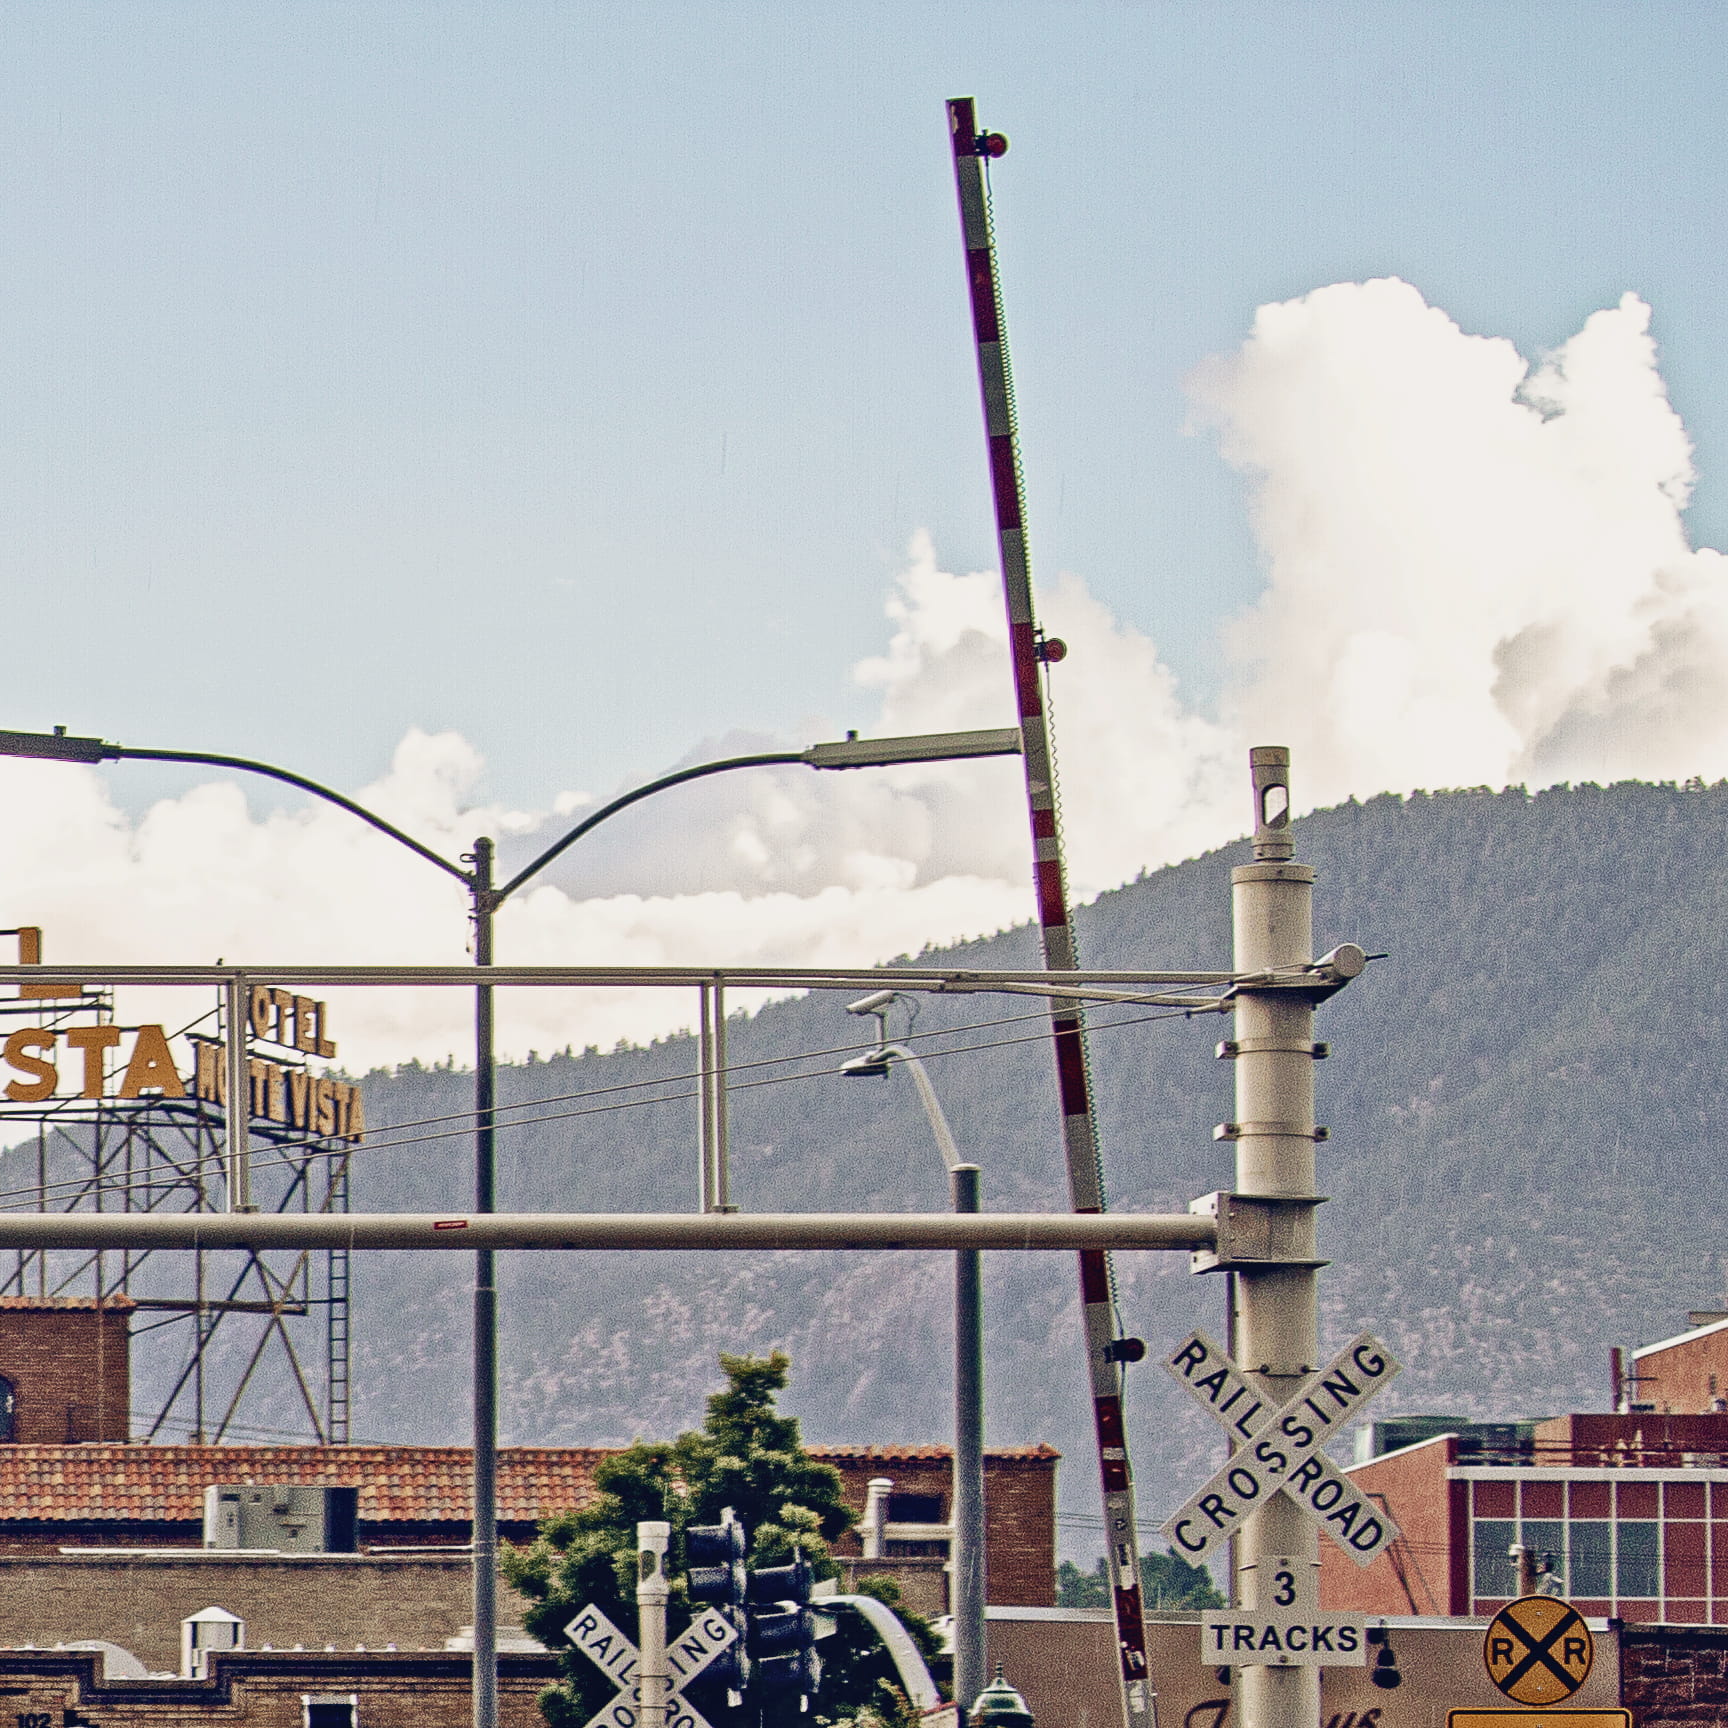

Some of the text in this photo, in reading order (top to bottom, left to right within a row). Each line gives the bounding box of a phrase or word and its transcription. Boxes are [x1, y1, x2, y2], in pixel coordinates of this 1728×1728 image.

[250, 985, 336, 1057] OTEL
[290, 1068, 364, 1143] VISTA
[1172, 1339, 1383, 1551] RAIL ROAD
[1175, 1345, 1385, 1552] CROSSING
[1274, 1571, 1296, 1606] 3
[573, 1615, 637, 1685] RAIL
[1210, 1624, 1358, 1652] TRACKS
